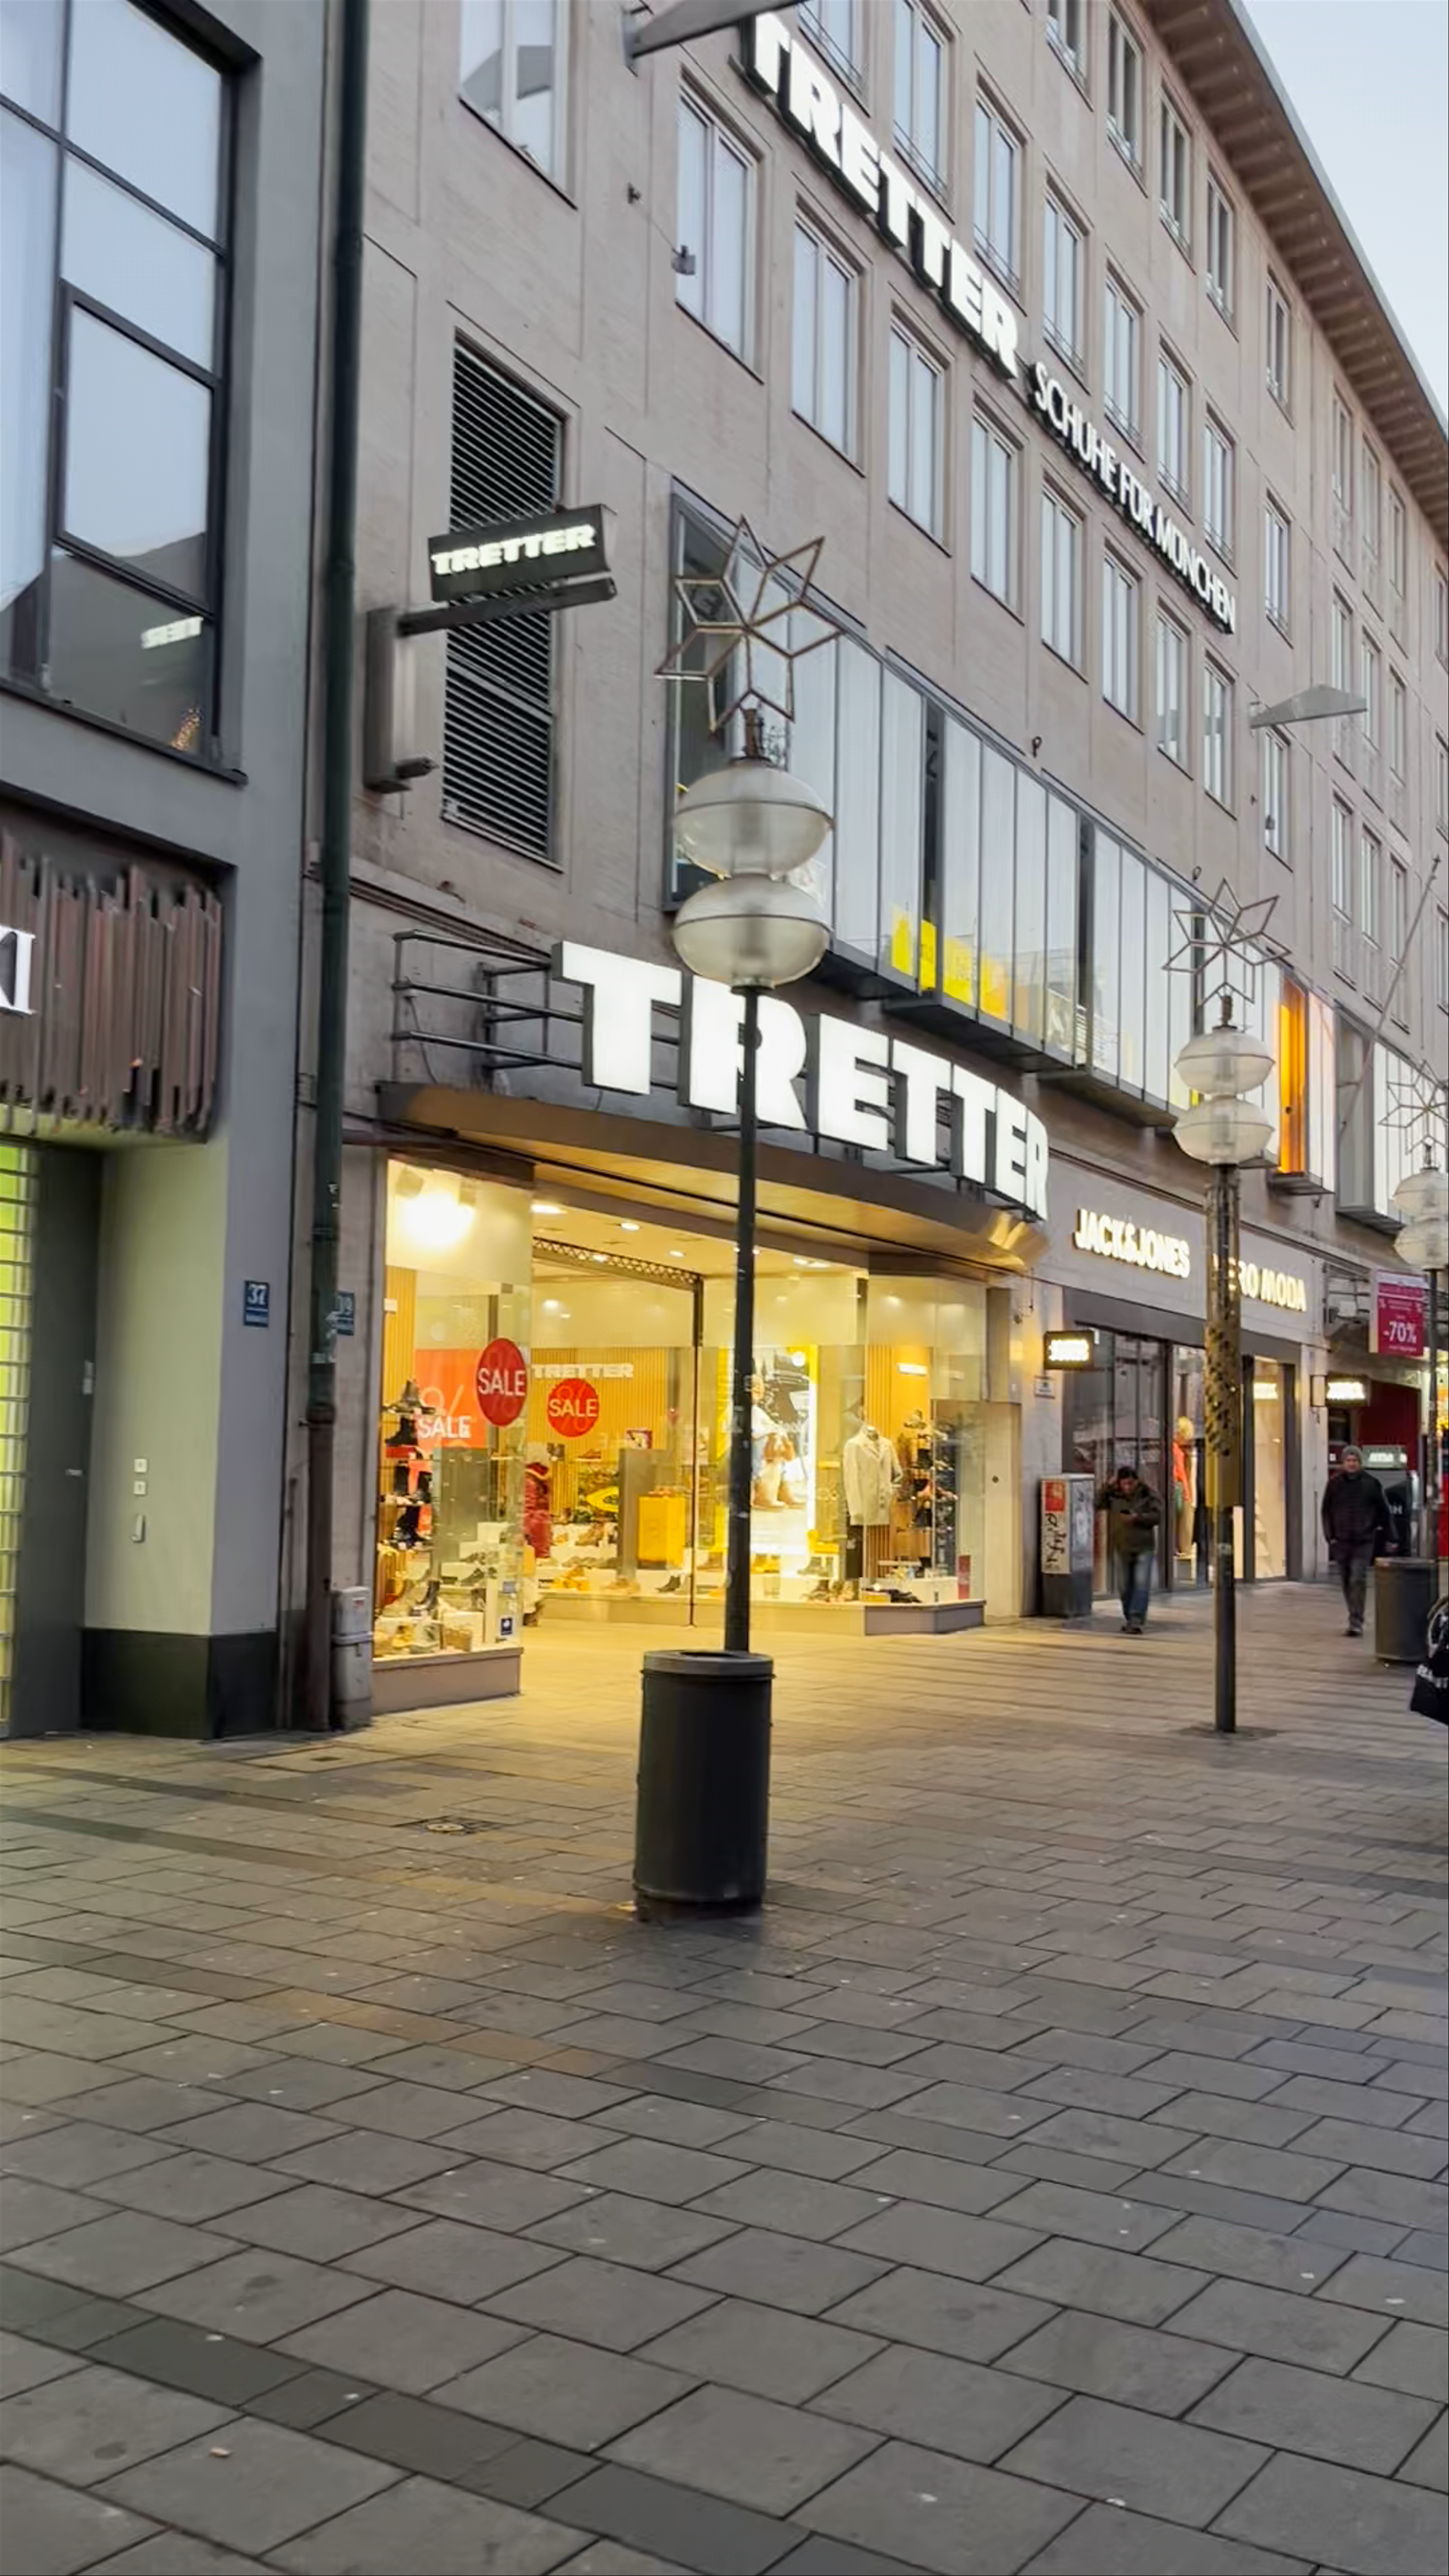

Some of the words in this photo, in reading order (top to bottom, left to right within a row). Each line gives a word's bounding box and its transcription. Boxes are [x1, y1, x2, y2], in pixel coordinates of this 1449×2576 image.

[755, 12, 1020, 378] TRETTER
[1035, 360, 1117, 493] SCHUHE
[431, 524, 596, 575] TRETTER
[560, 940, 1049, 1221] TRETTER
[248, 1284, 267, 1306] 37
[1260, 1268, 1307, 1312] MODA
[478, 1367, 526, 1396] SALE
[531, 1363, 633, 1378] TRETTER
[549, 1398, 598, 1417] SALE
[417, 1415, 472, 1439] SALE
